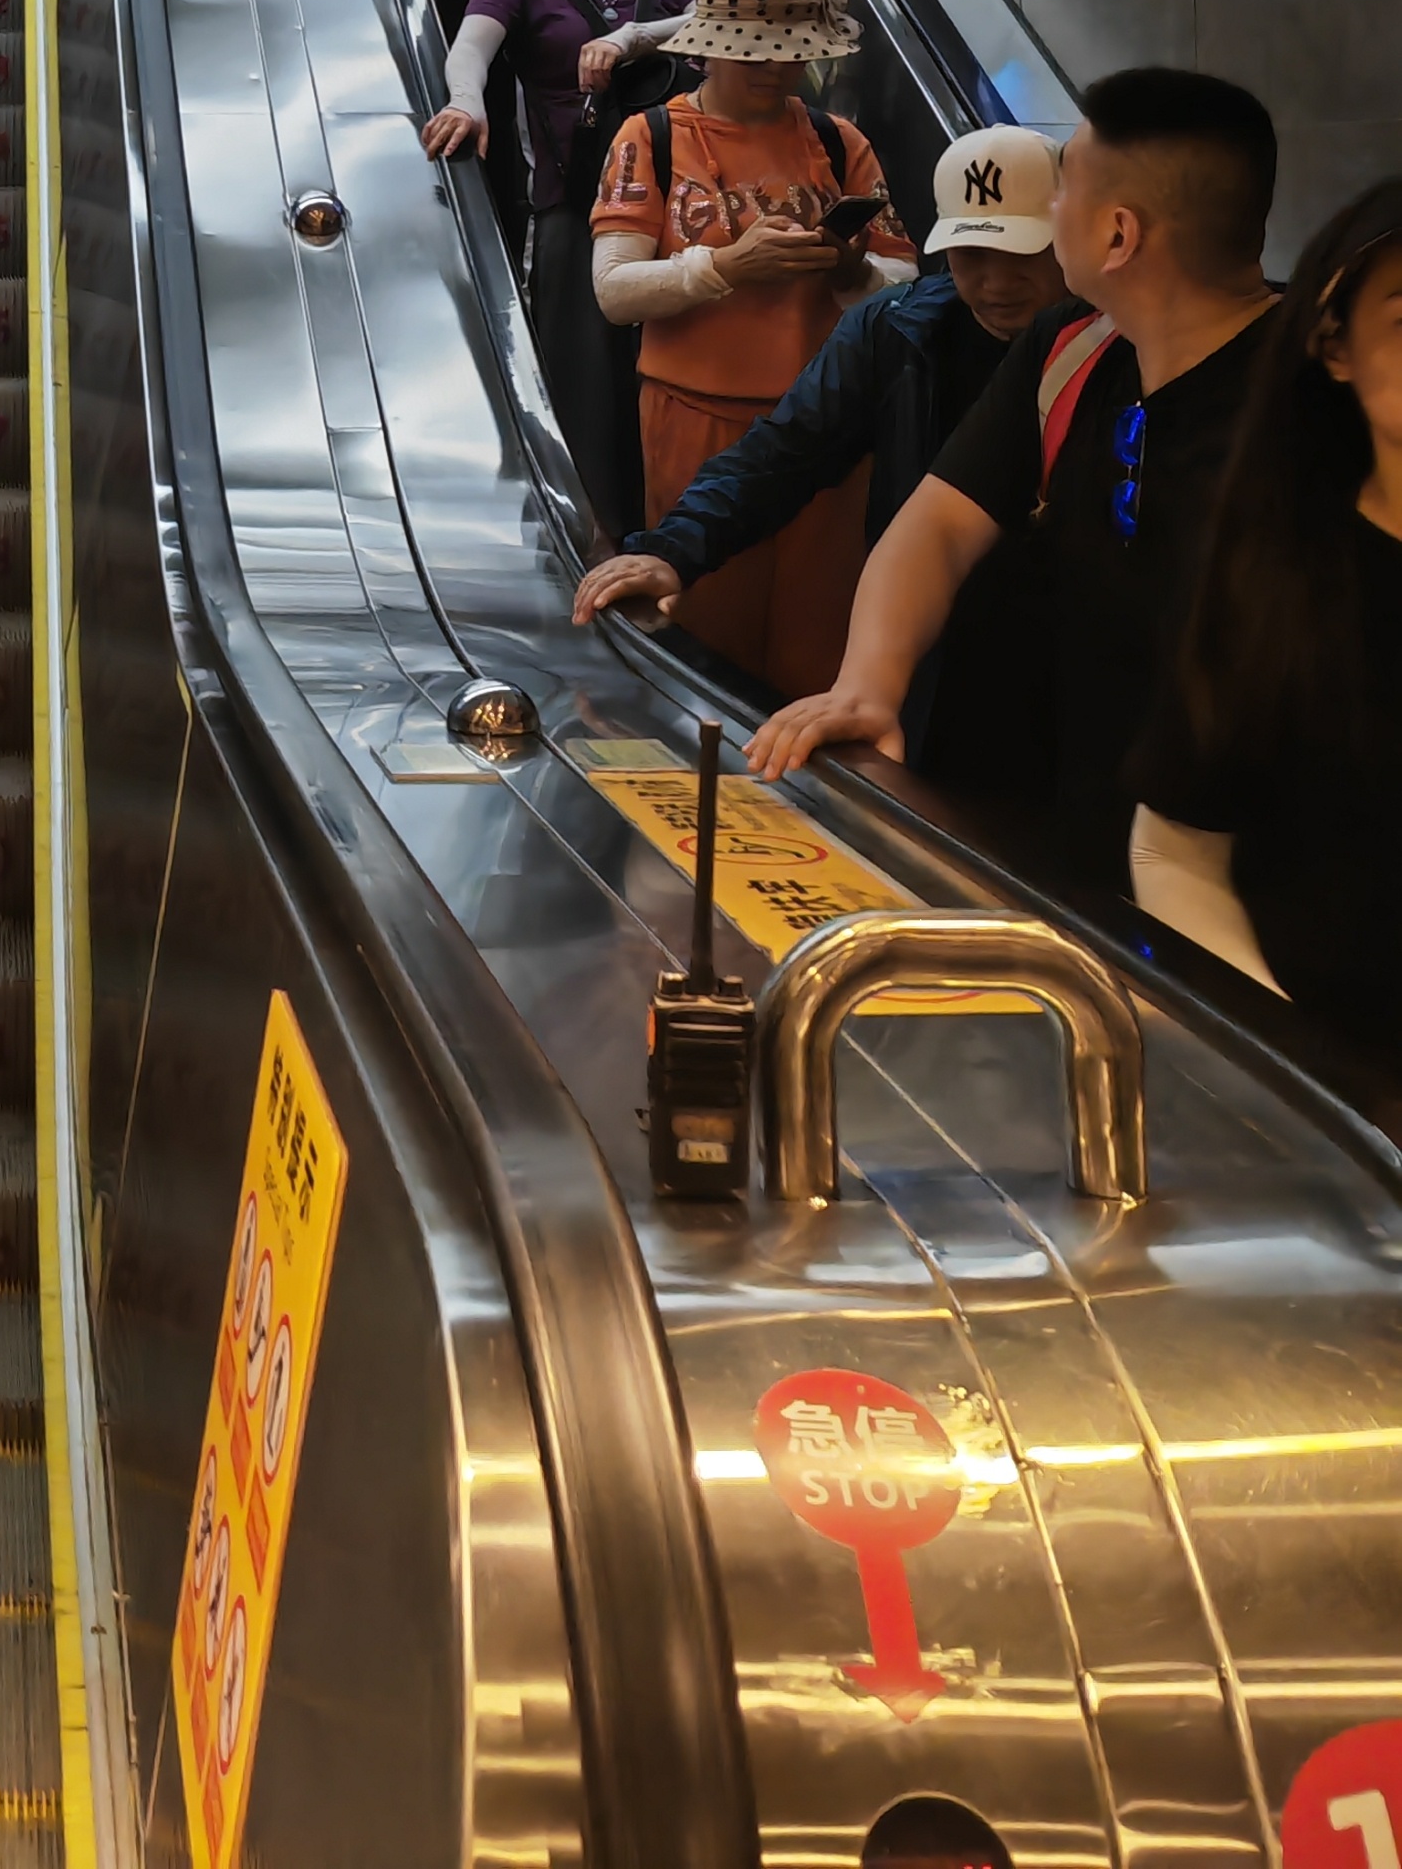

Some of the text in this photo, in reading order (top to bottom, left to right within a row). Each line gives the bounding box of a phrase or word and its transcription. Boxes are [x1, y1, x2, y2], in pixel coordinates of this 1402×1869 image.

[964, 159, 1003, 206] NY
[780, 1399, 926, 1463] 急停
[800, 1469, 930, 1511] STOP
